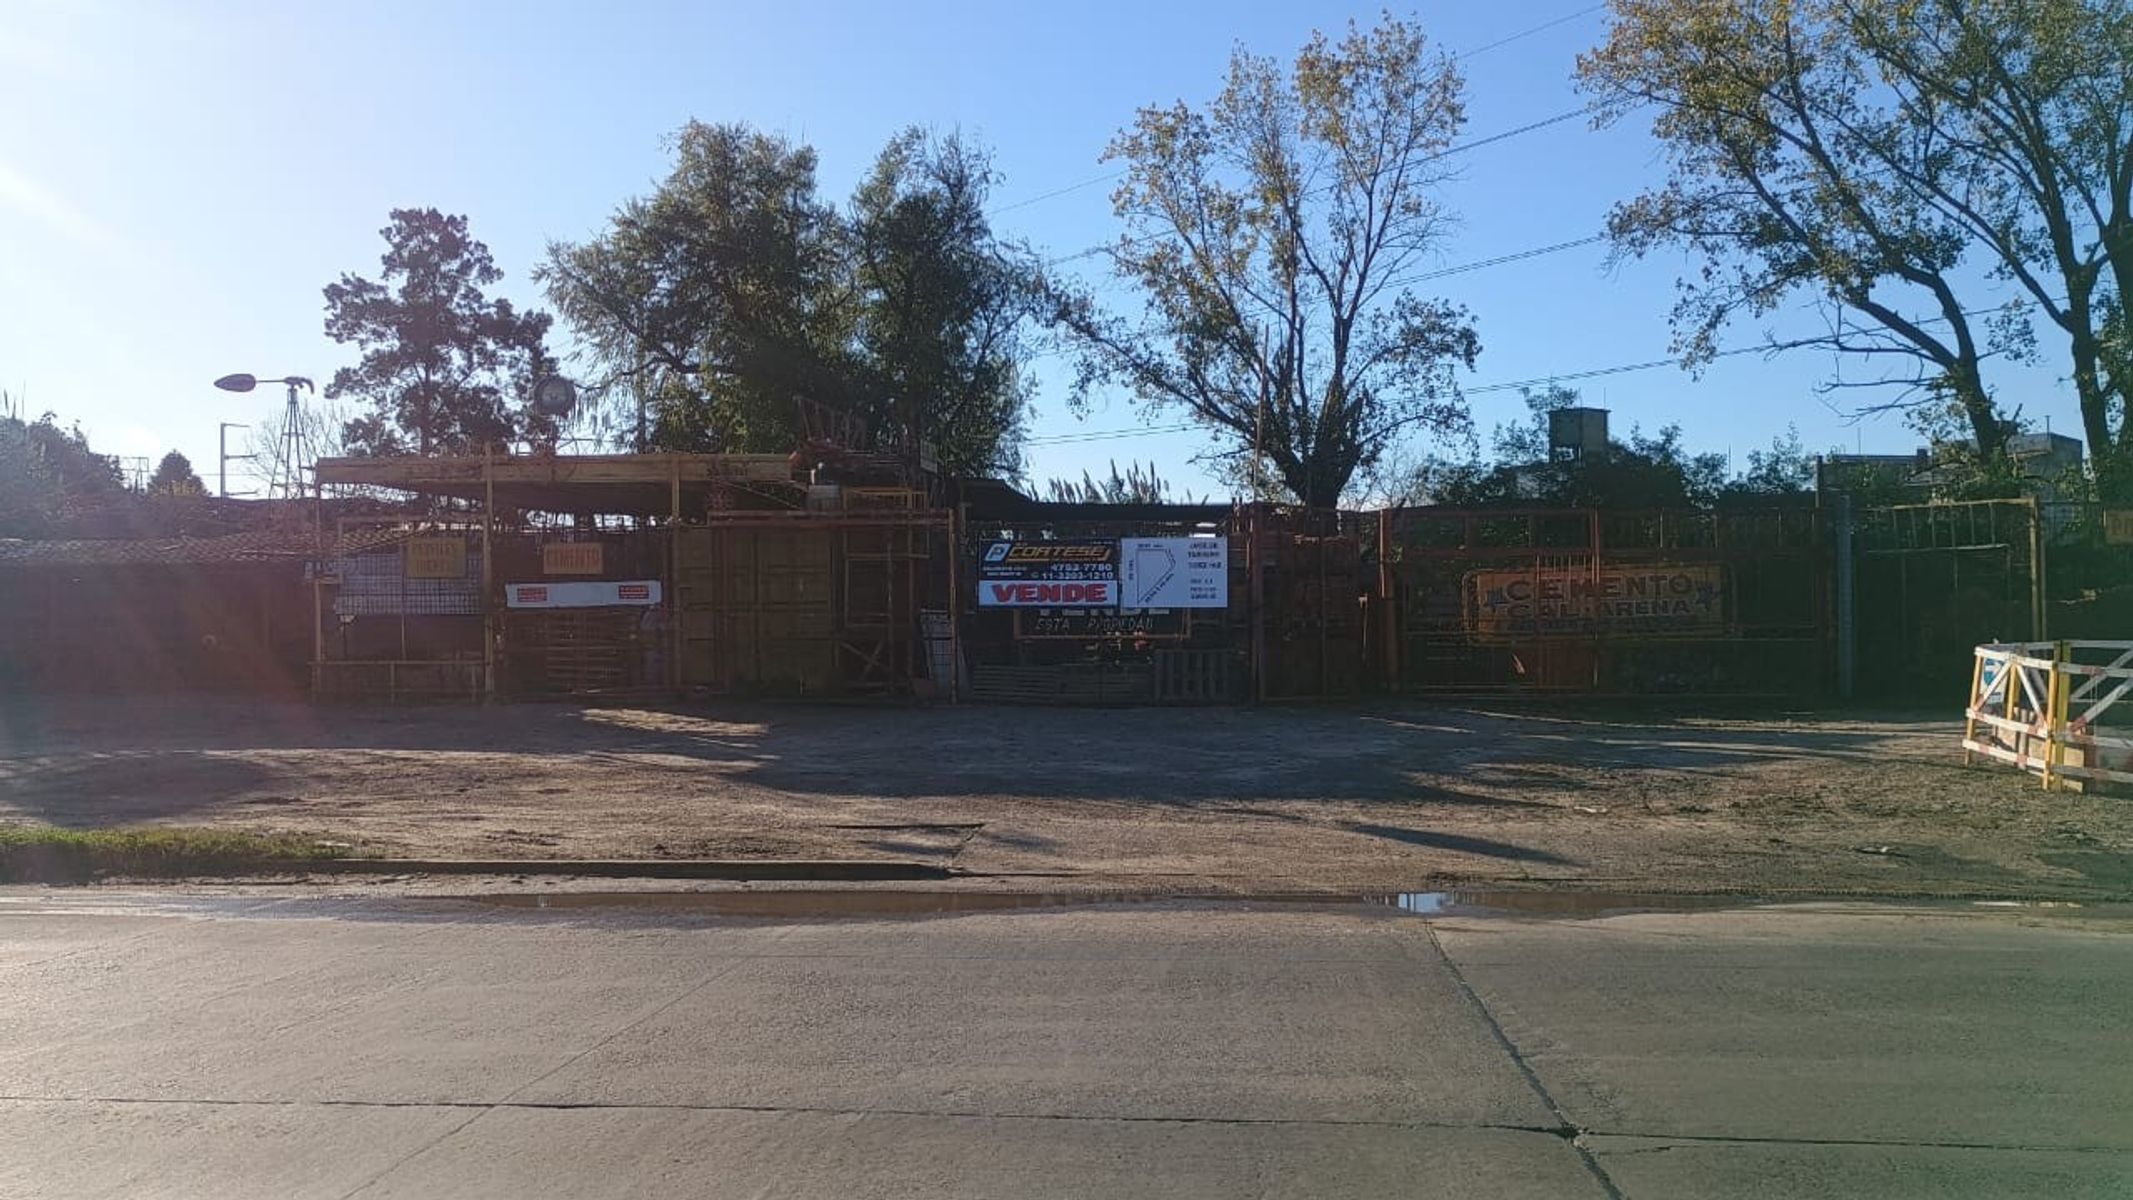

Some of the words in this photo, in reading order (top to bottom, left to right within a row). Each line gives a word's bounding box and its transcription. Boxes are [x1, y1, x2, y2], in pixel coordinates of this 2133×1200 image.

[1009, 545, 1106, 558] CORTESE
[991, 583, 1109, 603] VENDE
[1506, 573, 1692, 601] CEMENTO
